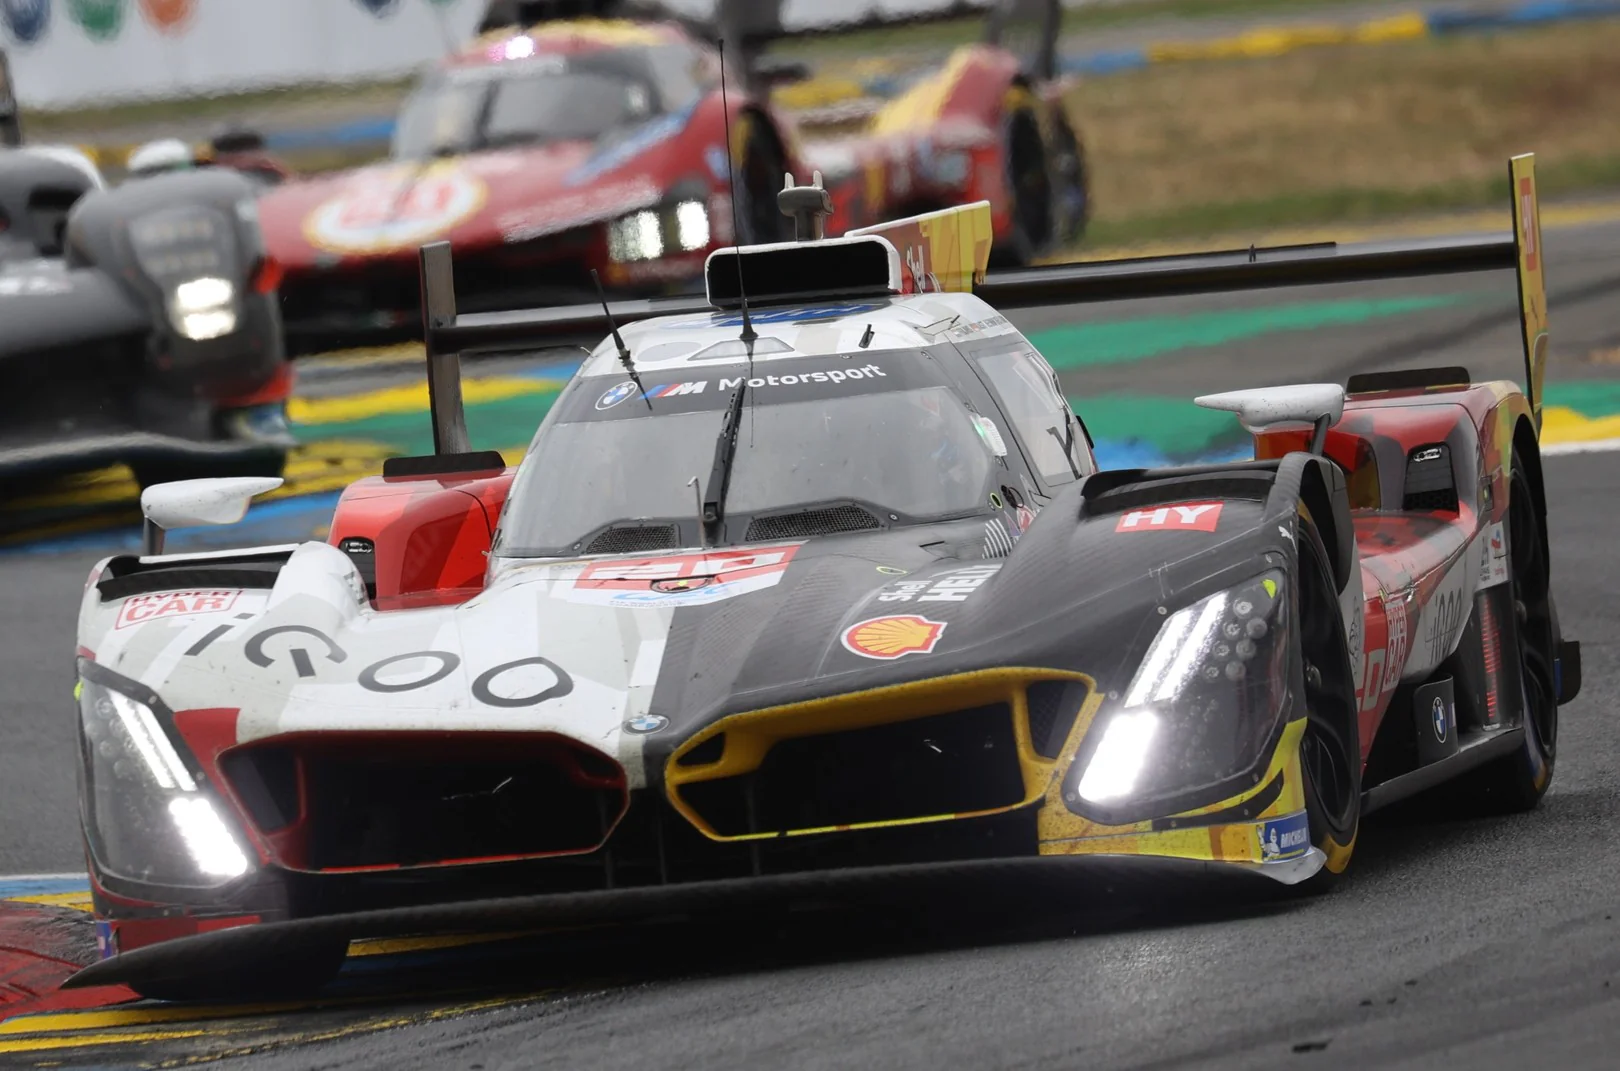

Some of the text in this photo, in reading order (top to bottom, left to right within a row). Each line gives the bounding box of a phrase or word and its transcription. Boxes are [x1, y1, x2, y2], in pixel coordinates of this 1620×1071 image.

[718, 363, 887, 391] Motorsport
[1122, 503, 1217, 527] HY
[125, 596, 226, 622] CAR
[131, 591, 231, 604] HYPER
[184, 612, 574, 708] iQOO
